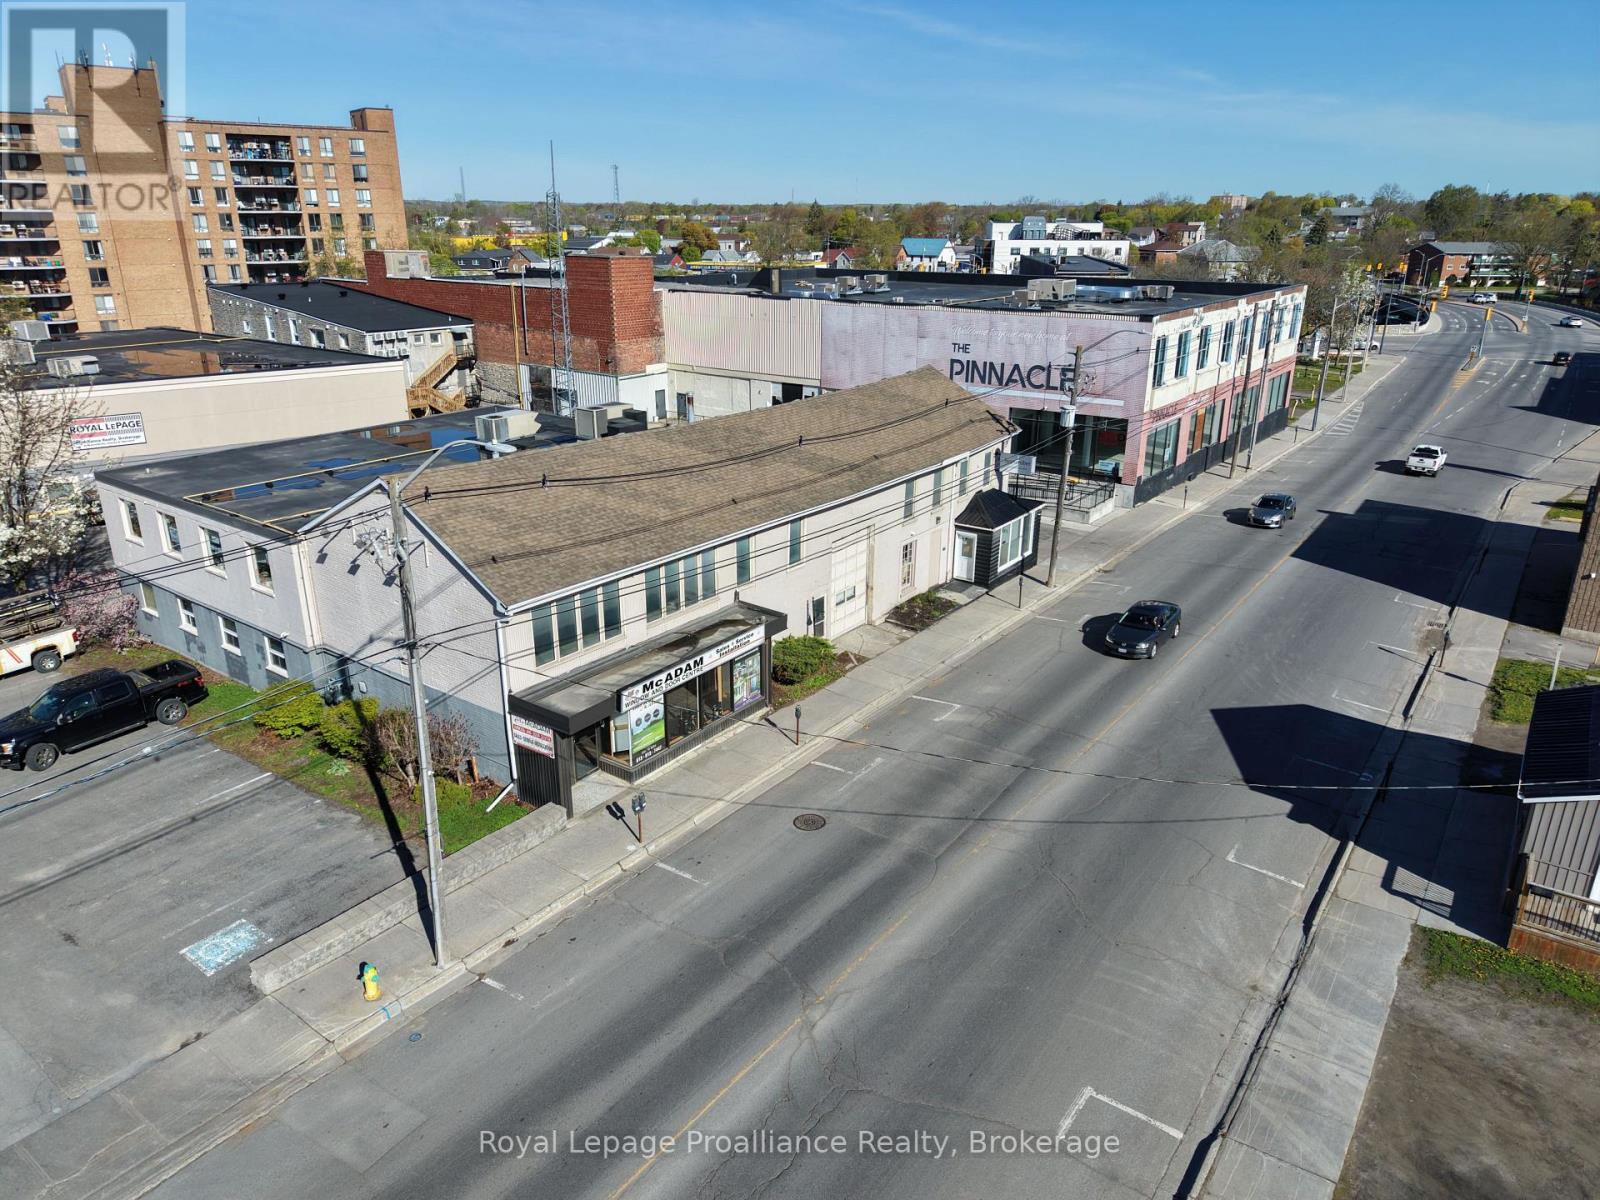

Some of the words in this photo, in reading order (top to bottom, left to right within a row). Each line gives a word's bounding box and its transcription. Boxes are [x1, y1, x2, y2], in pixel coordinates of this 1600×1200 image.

[952, 343, 971, 354] THE
[950, 358, 1077, 392] PINNACLE
[70, 424, 103, 434] ROYAL
[716, 644, 730, 655] Sales
[735, 632, 754, 644] Service
[719, 640, 751, 658] Installation
[642, 656, 704, 694] McADAM
[624, 691, 650, 708] WINDOW
[651, 686, 664, 696] AND
[665, 677, 681, 688] DOOR
[682, 666, 704, 680] CENTRE
